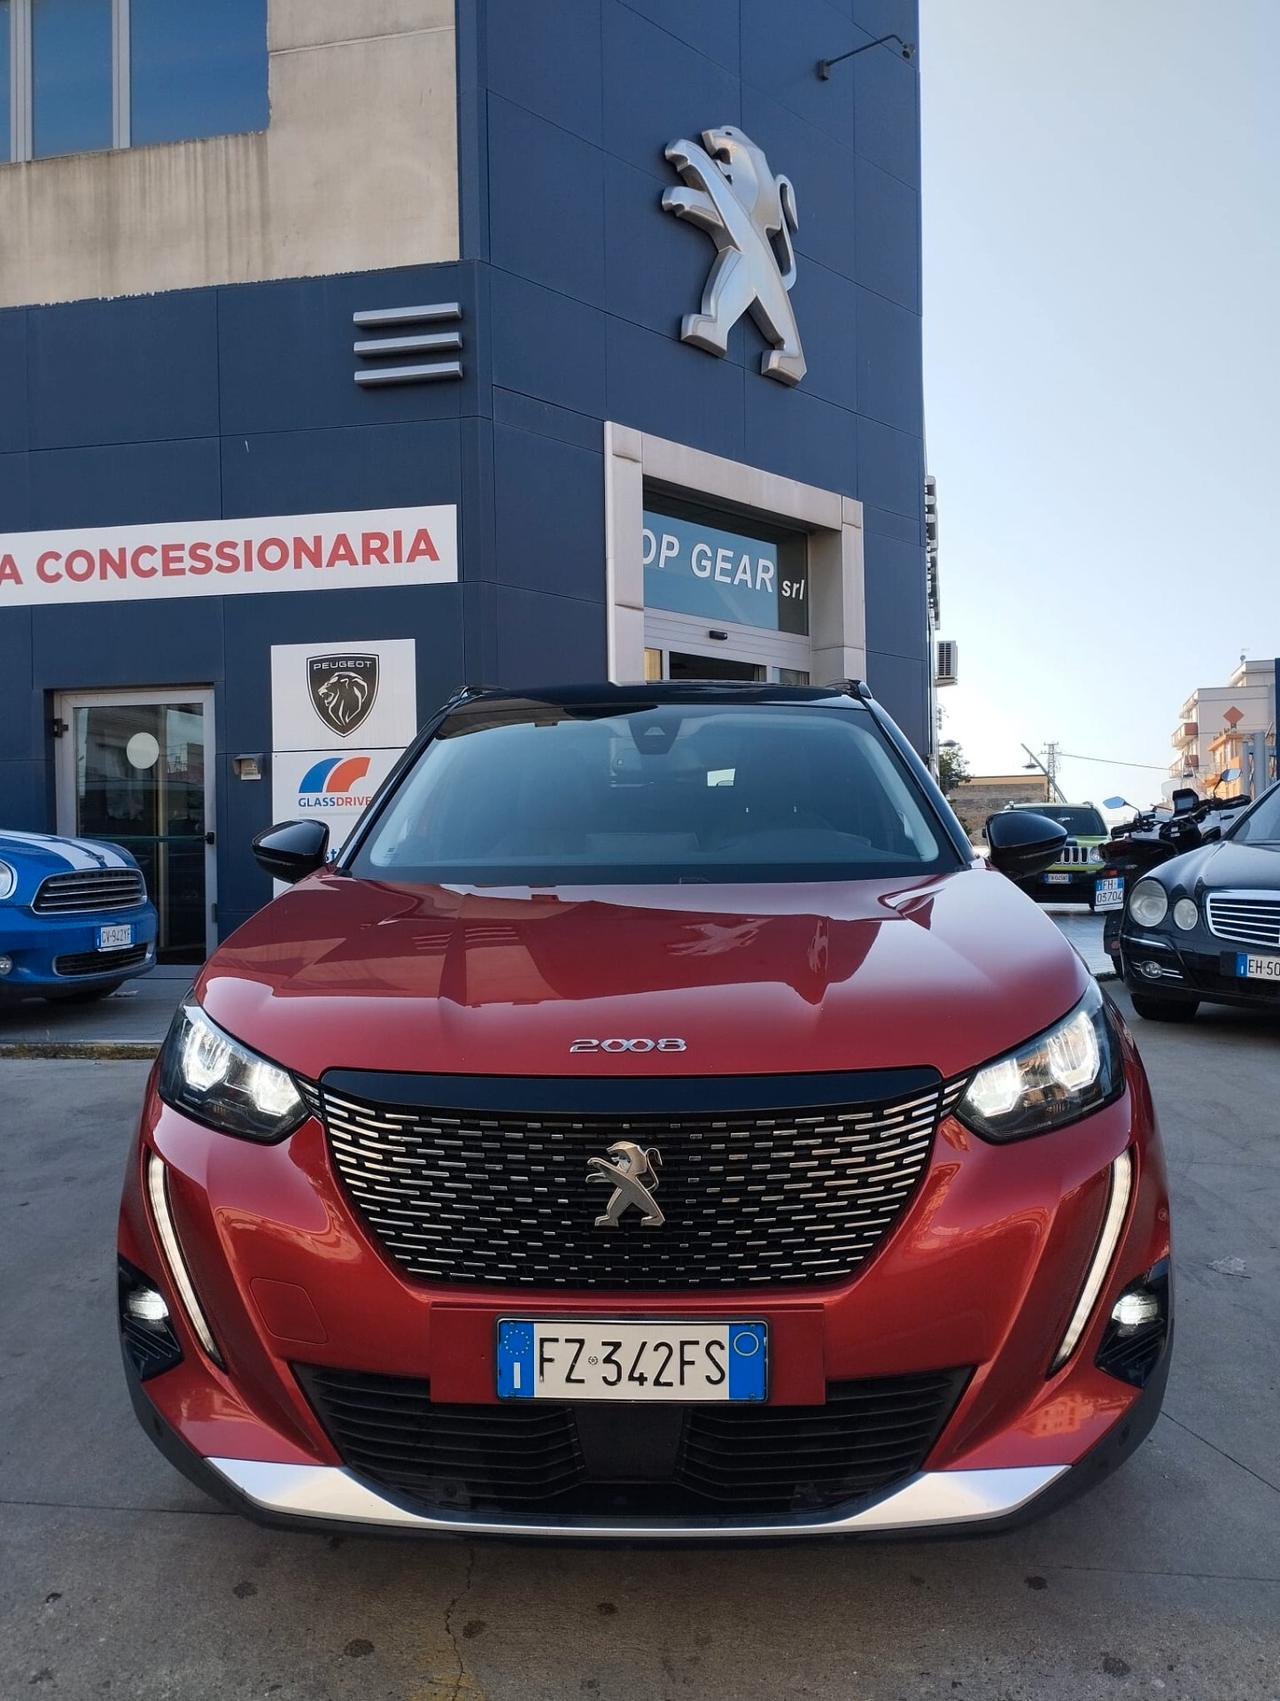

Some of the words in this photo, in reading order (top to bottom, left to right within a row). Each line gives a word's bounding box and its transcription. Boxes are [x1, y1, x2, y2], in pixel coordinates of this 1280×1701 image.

[0, 554, 24, 586] A
[36, 528, 440, 584] CONCESSIONARIA
[691, 543, 776, 593] GEAR
[781, 579, 805, 600] srl
[313, 660, 373, 670] PEUGEOT
[569, 1038, 688, 1054] 2008
